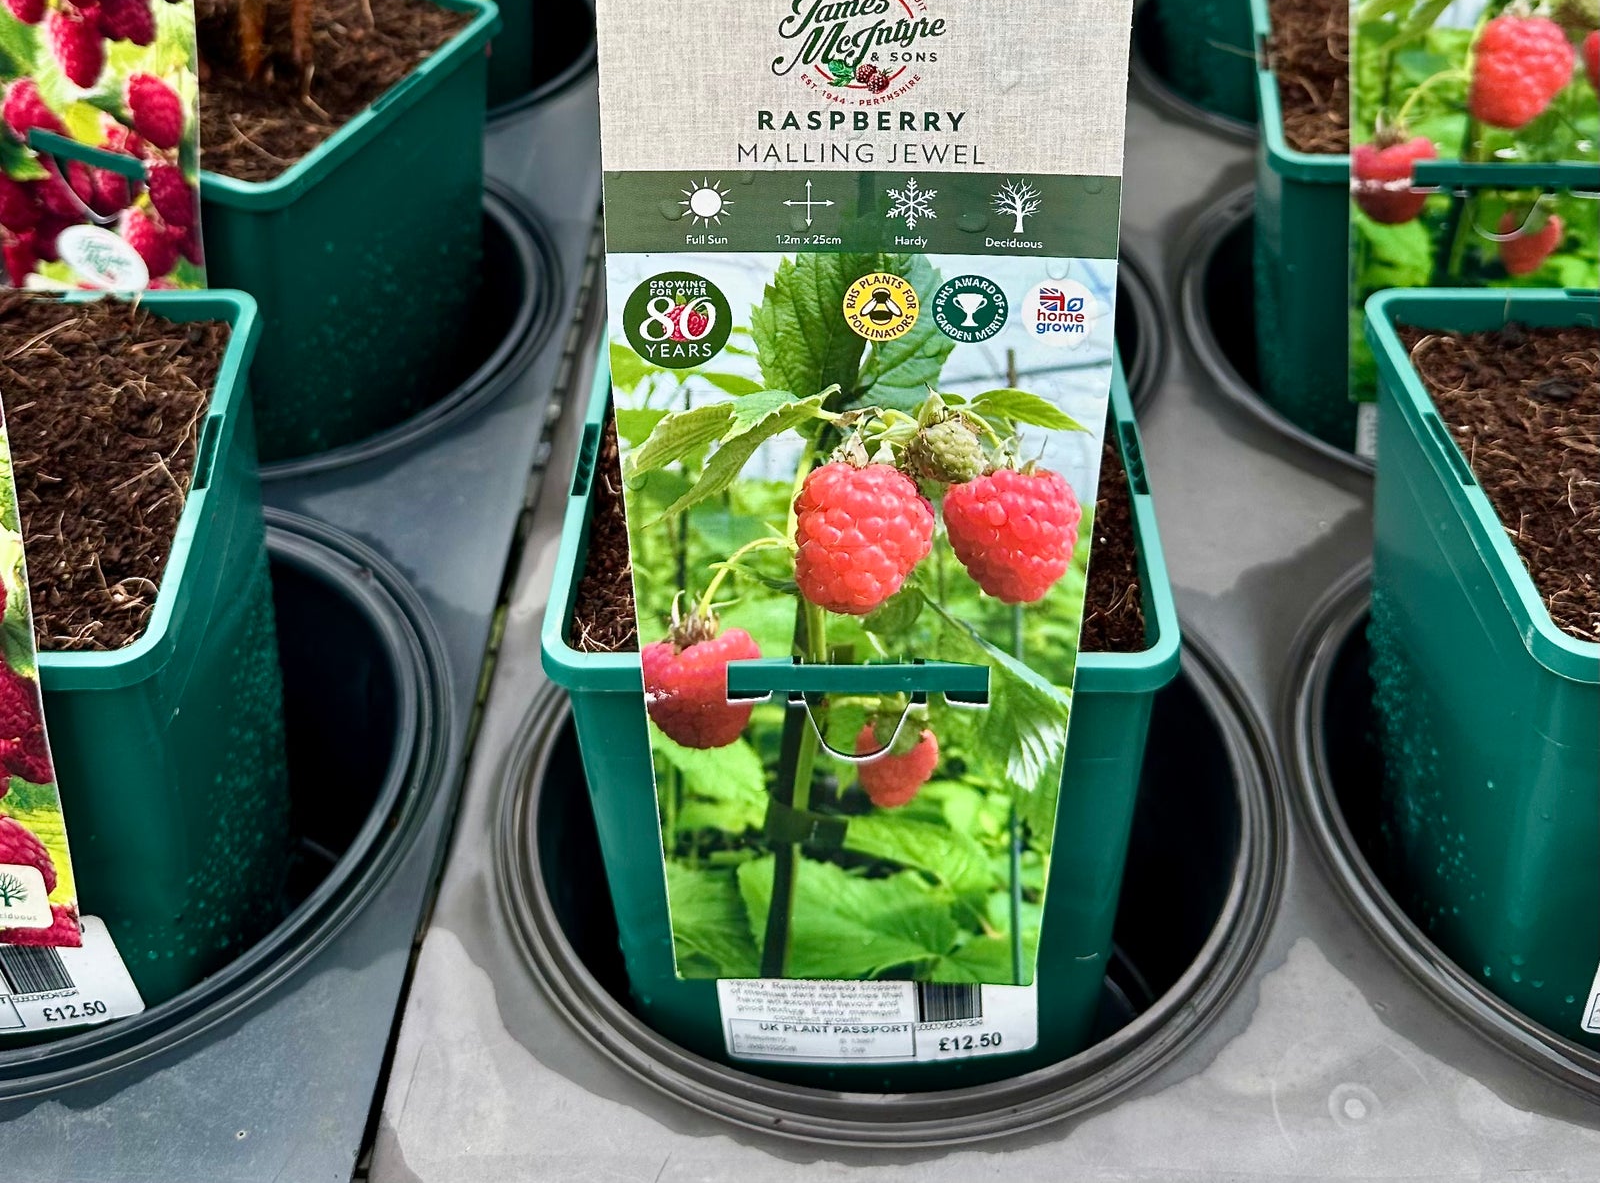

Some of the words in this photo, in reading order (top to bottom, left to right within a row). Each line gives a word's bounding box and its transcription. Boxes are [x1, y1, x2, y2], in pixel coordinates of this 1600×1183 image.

[771, 16, 947, 77] McIntyre
[870, 51, 880, 62] &
[890, 51, 938, 63] SONS
[800, 73, 818, 93] EST.
[821, 89, 846, 105] 1944
[859, 74, 921, 107] PERTHSHIRE
[757, 110, 966, 132] RASPBERRY
[737, 143, 874, 164] MALLING
[887, 143, 986, 165] JEWEL
[685, 234, 705, 245] Full
[707, 234, 728, 245] Sun
[776, 235, 801, 245] 1.2m
[803, 237, 810, 245] x
[812, 235, 842, 245] 25cm
[894, 236, 928, 249] Hardy
[985, 236, 1043, 249] Deciduous
[649, 280, 707, 288] GROWING
[649, 288, 672, 296] FOR
[676, 287, 707, 296] OVER
[846, 288, 860, 309] RHS
[859, 275, 904, 290] PLANTS
[902, 288, 917, 309] FOR
[935, 285, 954, 306] RHS
[955, 277, 996, 295] AWARD
[992, 293, 1006, 308] OF
[638, 296, 717, 341] 80
[1037, 308, 1085, 323] home
[848, 313, 914, 339] POLLINATORS
[936, 313, 972, 341] GARDEN
[974, 313, 1004, 341] MERIT
[1036, 322, 1084, 334] grown
[645, 343, 713, 358] YEARS
[42, 1000, 107, 1022] £12.50
[760, 1023, 780, 1031] UK
[783, 1024, 829, 1033] PLANT
[834, 1024, 908, 1033] PASSPORT
[939, 1031, 1002, 1051] £12.50
